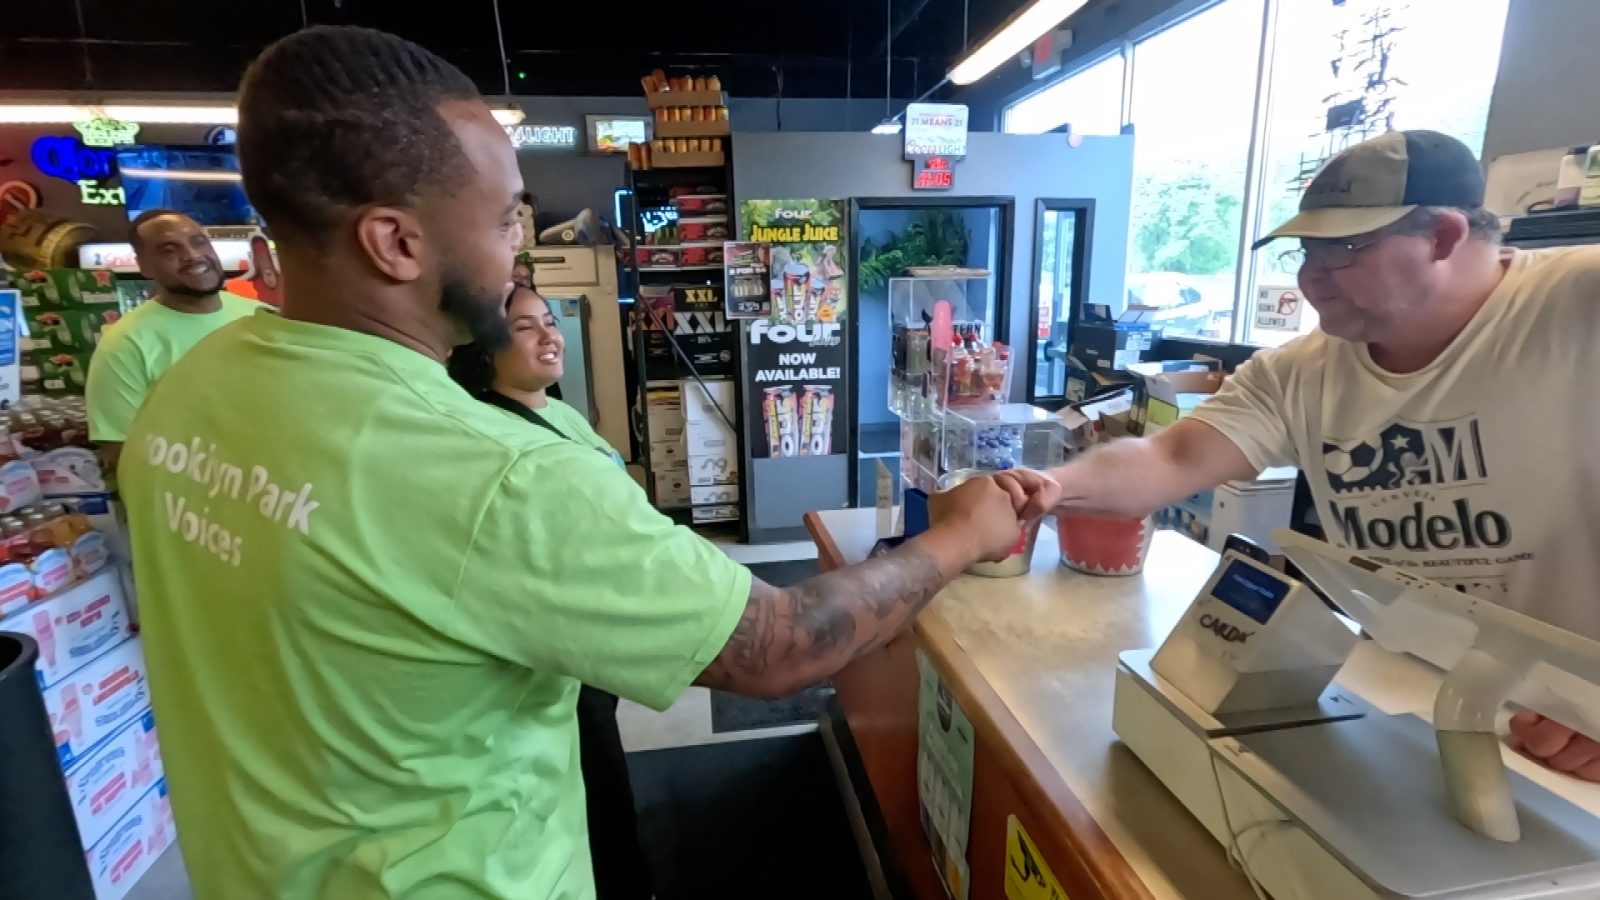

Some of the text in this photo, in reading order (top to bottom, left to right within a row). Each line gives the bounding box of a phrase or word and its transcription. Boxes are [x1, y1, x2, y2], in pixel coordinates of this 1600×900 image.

[921, 118, 953, 126] MEANS
[774, 208, 813, 219] four
[685, 289, 718, 303] XXL
[674, 311, 732, 335] XXL
[750, 320, 841, 345] four
[779, 352, 817, 366] NOW
[755, 367, 841, 382] AVAILABLE!
[246, 464, 320, 535] Park
[165, 491, 243, 567] Voices
[1329, 497, 1512, 552] Modelo
